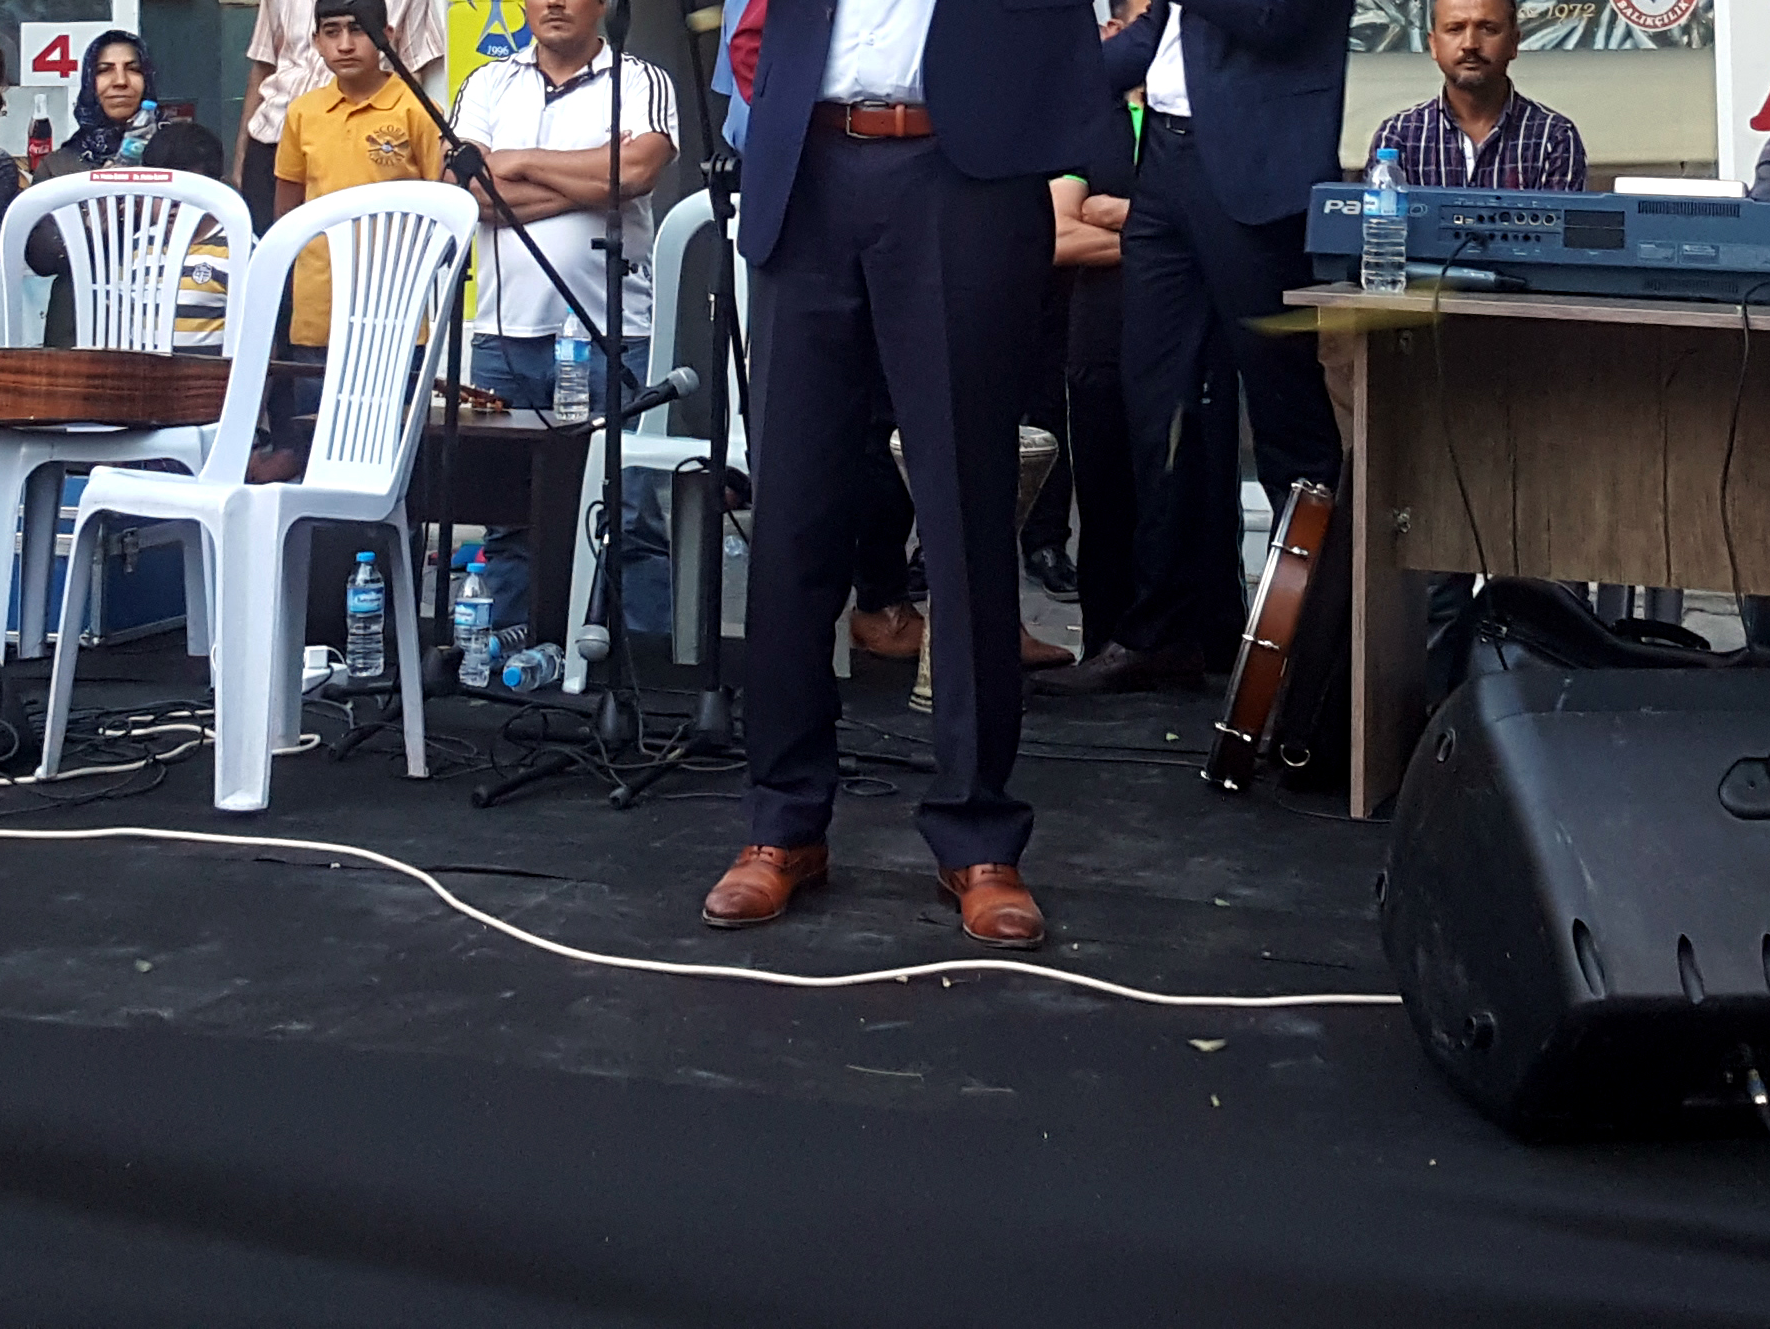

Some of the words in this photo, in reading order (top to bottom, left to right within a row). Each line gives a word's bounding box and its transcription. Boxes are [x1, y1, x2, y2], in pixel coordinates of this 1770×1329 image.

[1547, 2, 1597, 21] 1972
[1615, 0, 1690, 31] BALIKÇILIK
[32, 34, 78, 78] 4
